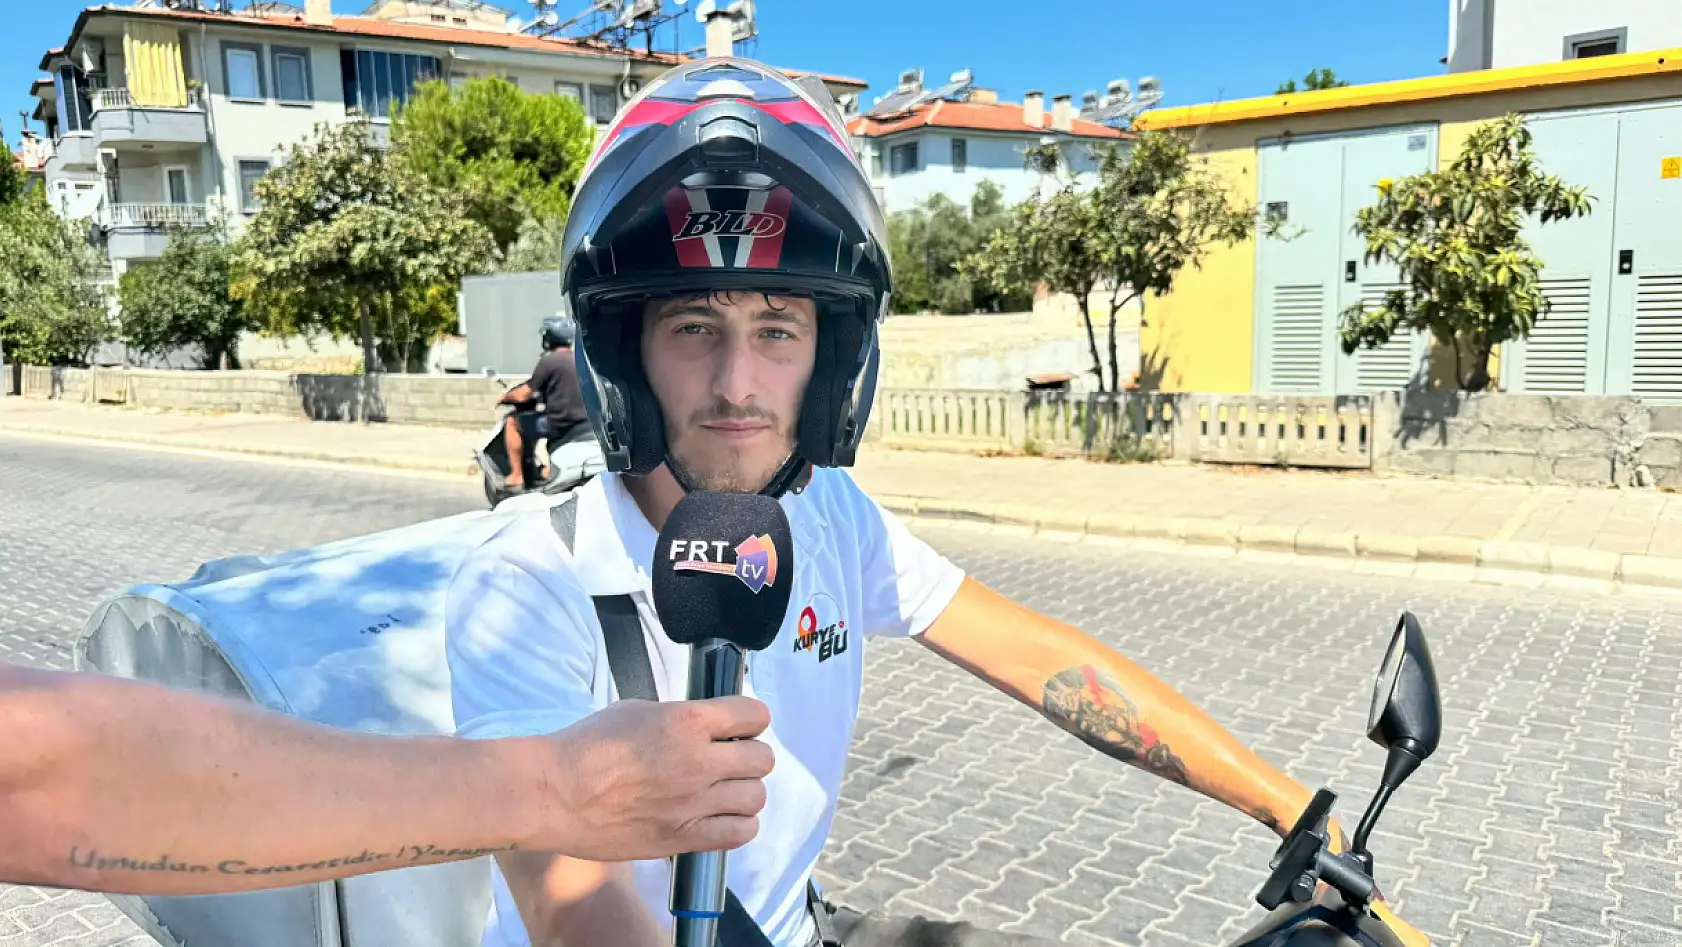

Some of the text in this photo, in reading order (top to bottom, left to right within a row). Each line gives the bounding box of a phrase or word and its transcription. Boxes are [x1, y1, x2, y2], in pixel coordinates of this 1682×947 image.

[672, 210, 786, 242] BLD
[670, 540, 729, 563] FRT
[741, 559, 765, 579] tv
[793, 623, 837, 653] KURYE
